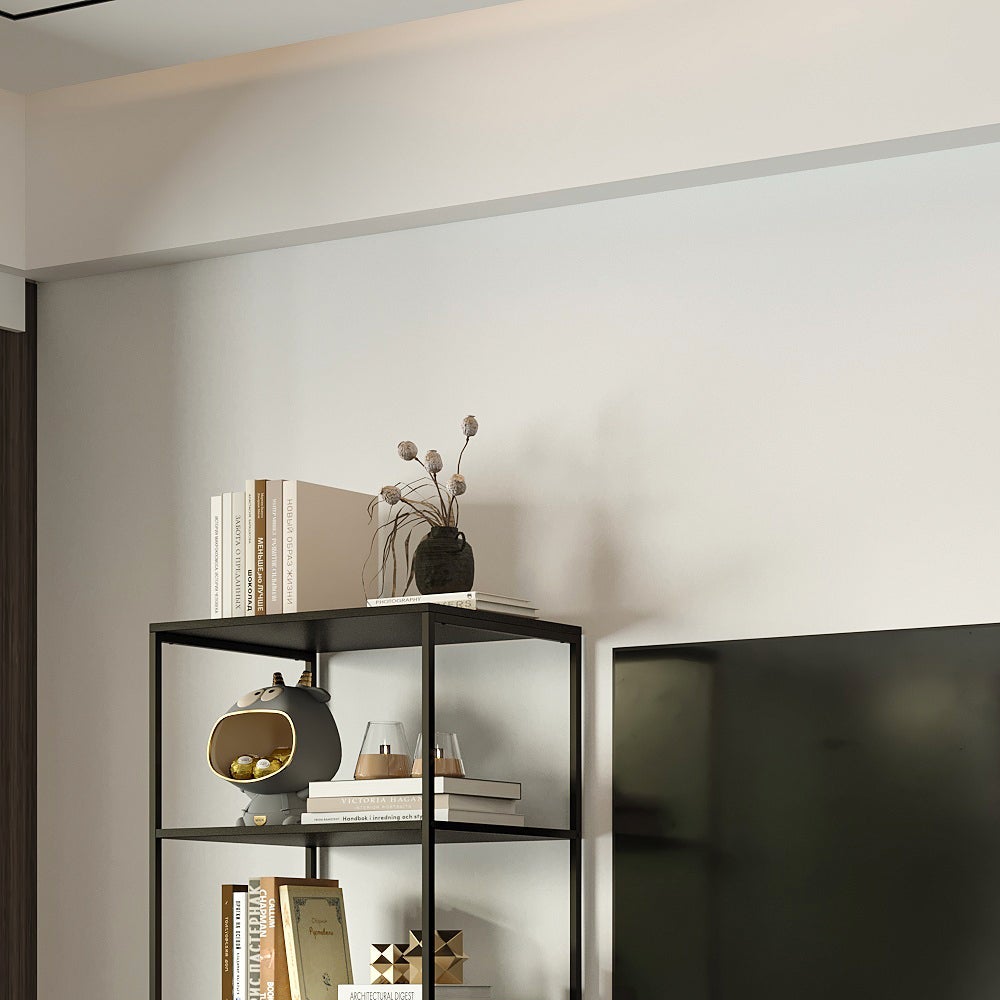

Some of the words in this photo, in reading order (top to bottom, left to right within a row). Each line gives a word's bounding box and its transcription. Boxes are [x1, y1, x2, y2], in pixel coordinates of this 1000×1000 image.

[375, 597, 422, 605] PHOTOGRAPHY
[259, 889, 267, 938] CHAPMAN
[249, 886, 261, 973] ПАСТЕРНАК
[349, 991, 393, 1000] ARCHITECTURAL
[394, 991, 415, 1000] DIGEST
